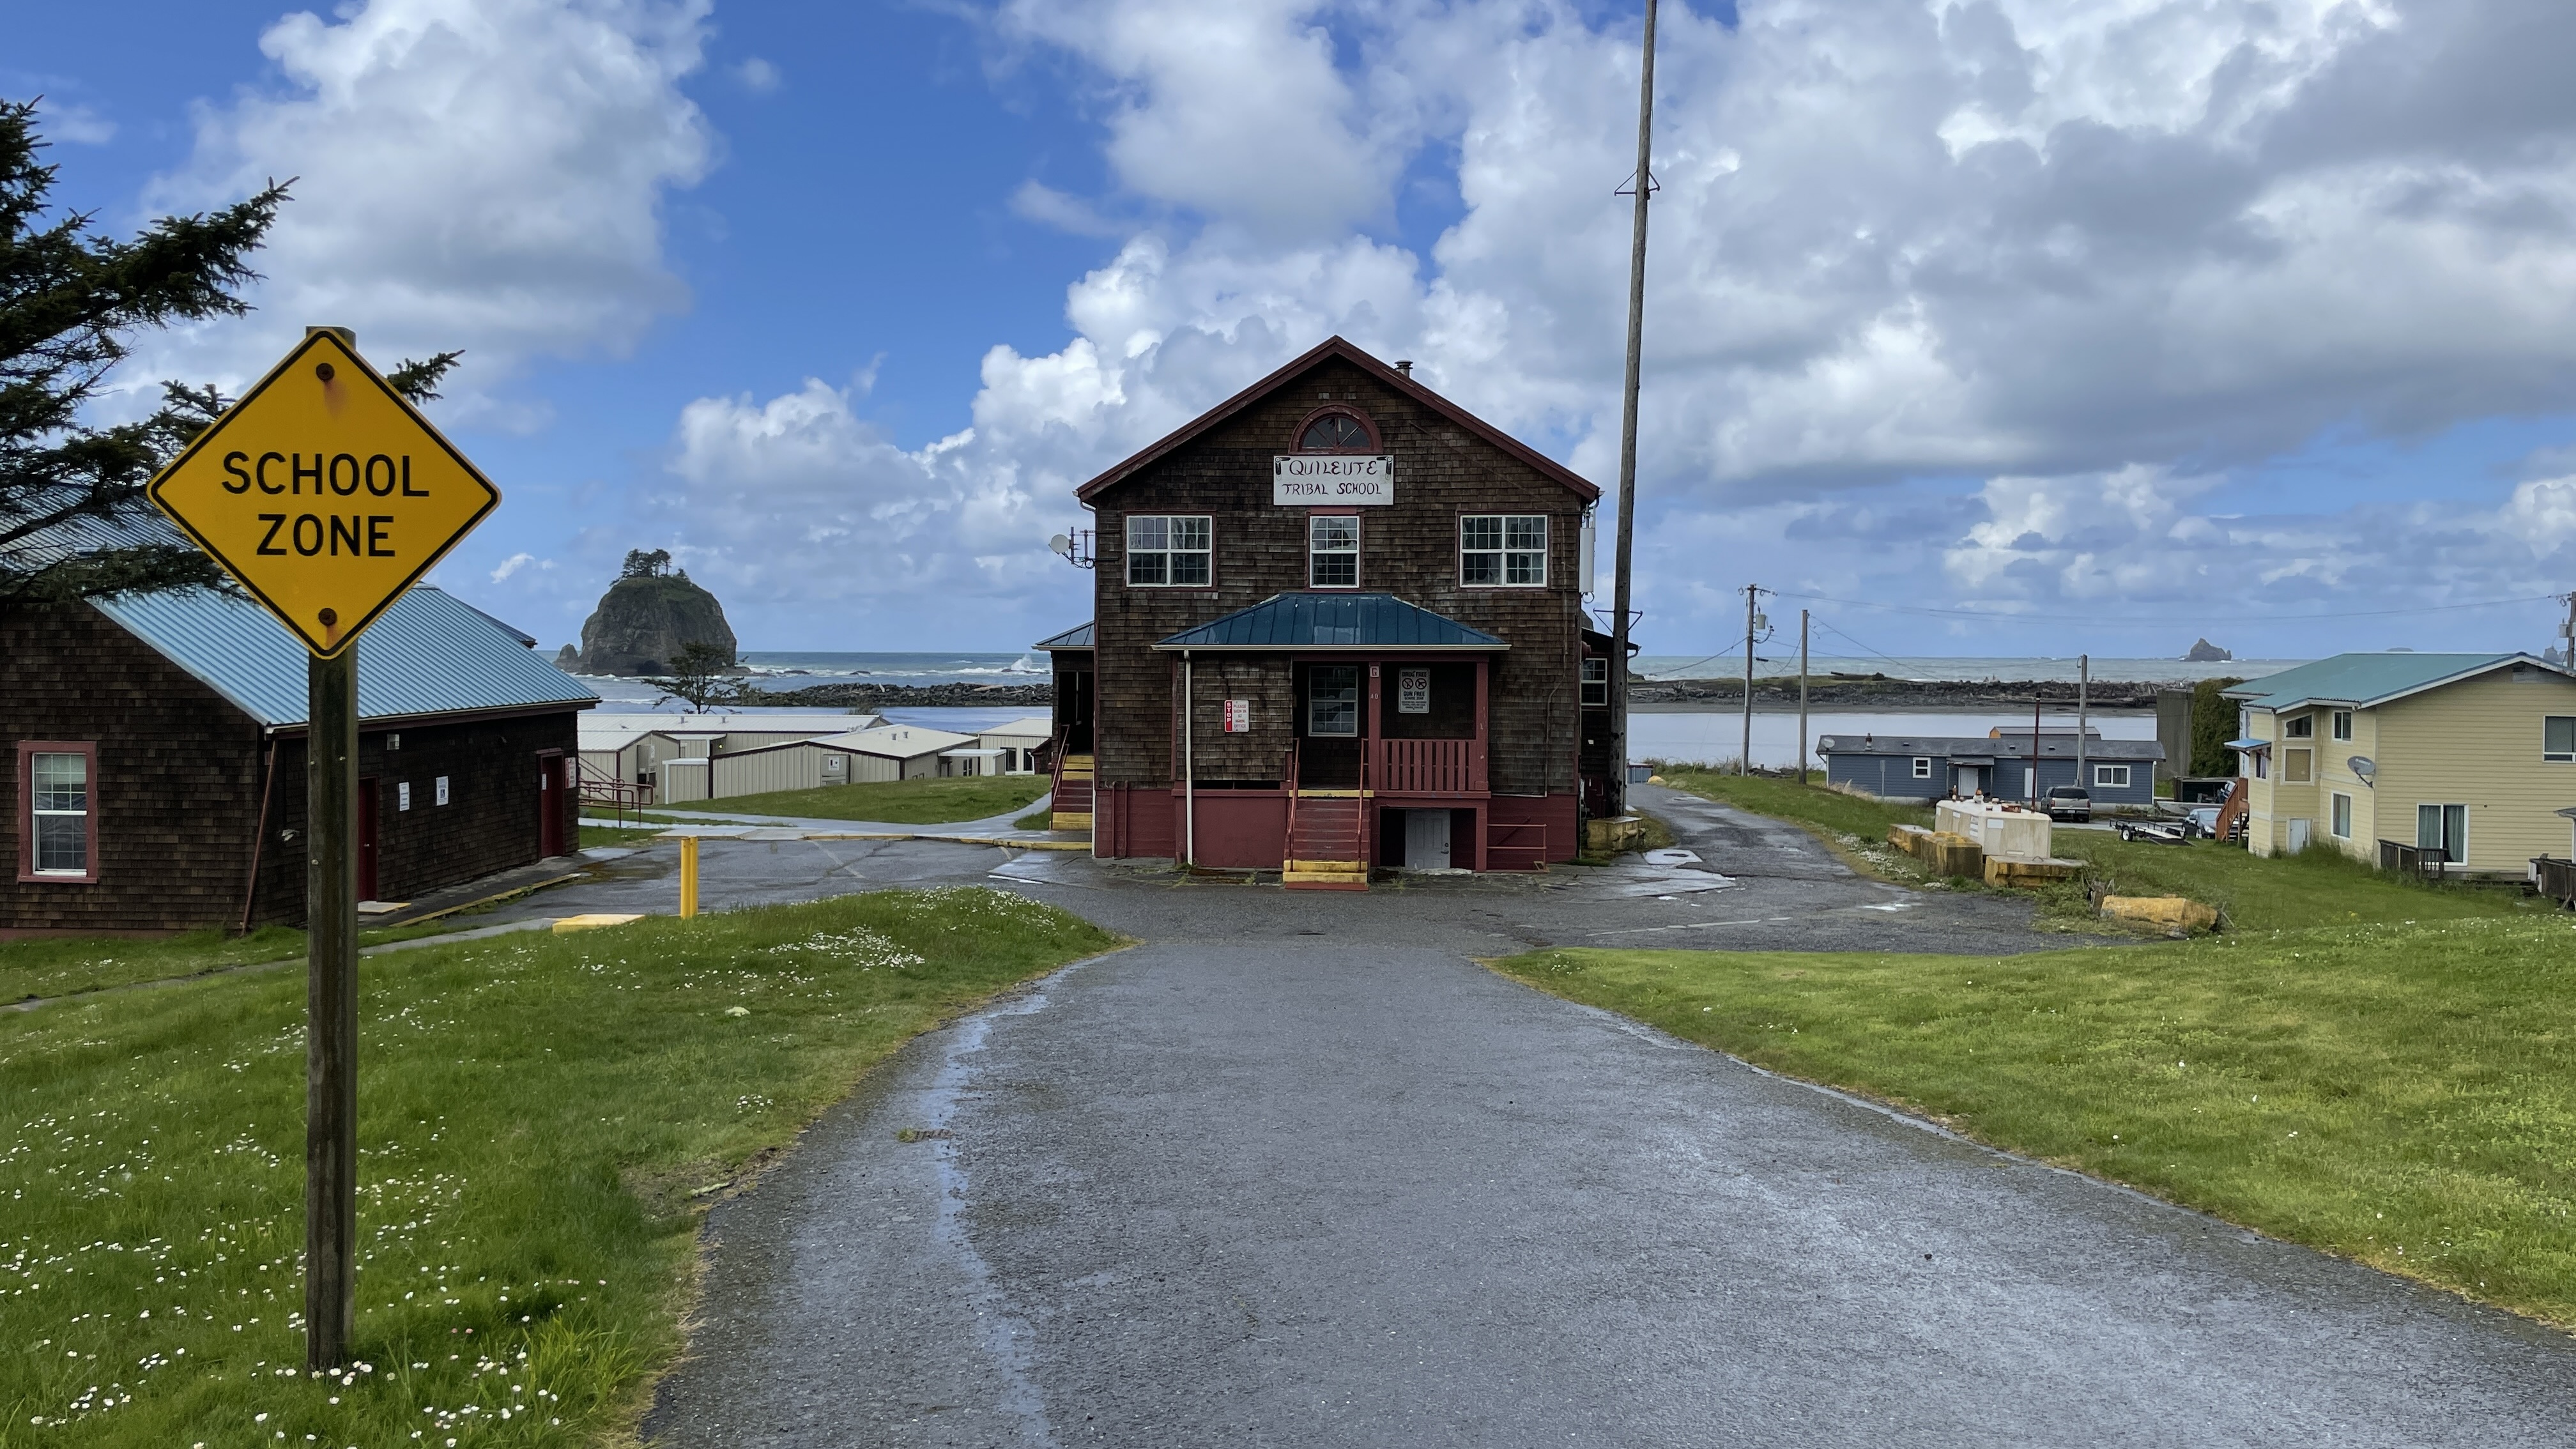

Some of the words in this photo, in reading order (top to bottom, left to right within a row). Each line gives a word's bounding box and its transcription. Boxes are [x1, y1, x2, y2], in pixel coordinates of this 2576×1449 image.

[222, 451, 429, 497] SCHOOL
[1289, 460, 1377, 475] QUILEUTE
[1282, 483, 1329, 495] TRIBAL
[1337, 482, 1382, 494] SCHOOL
[256, 514, 395, 556] ZONE
